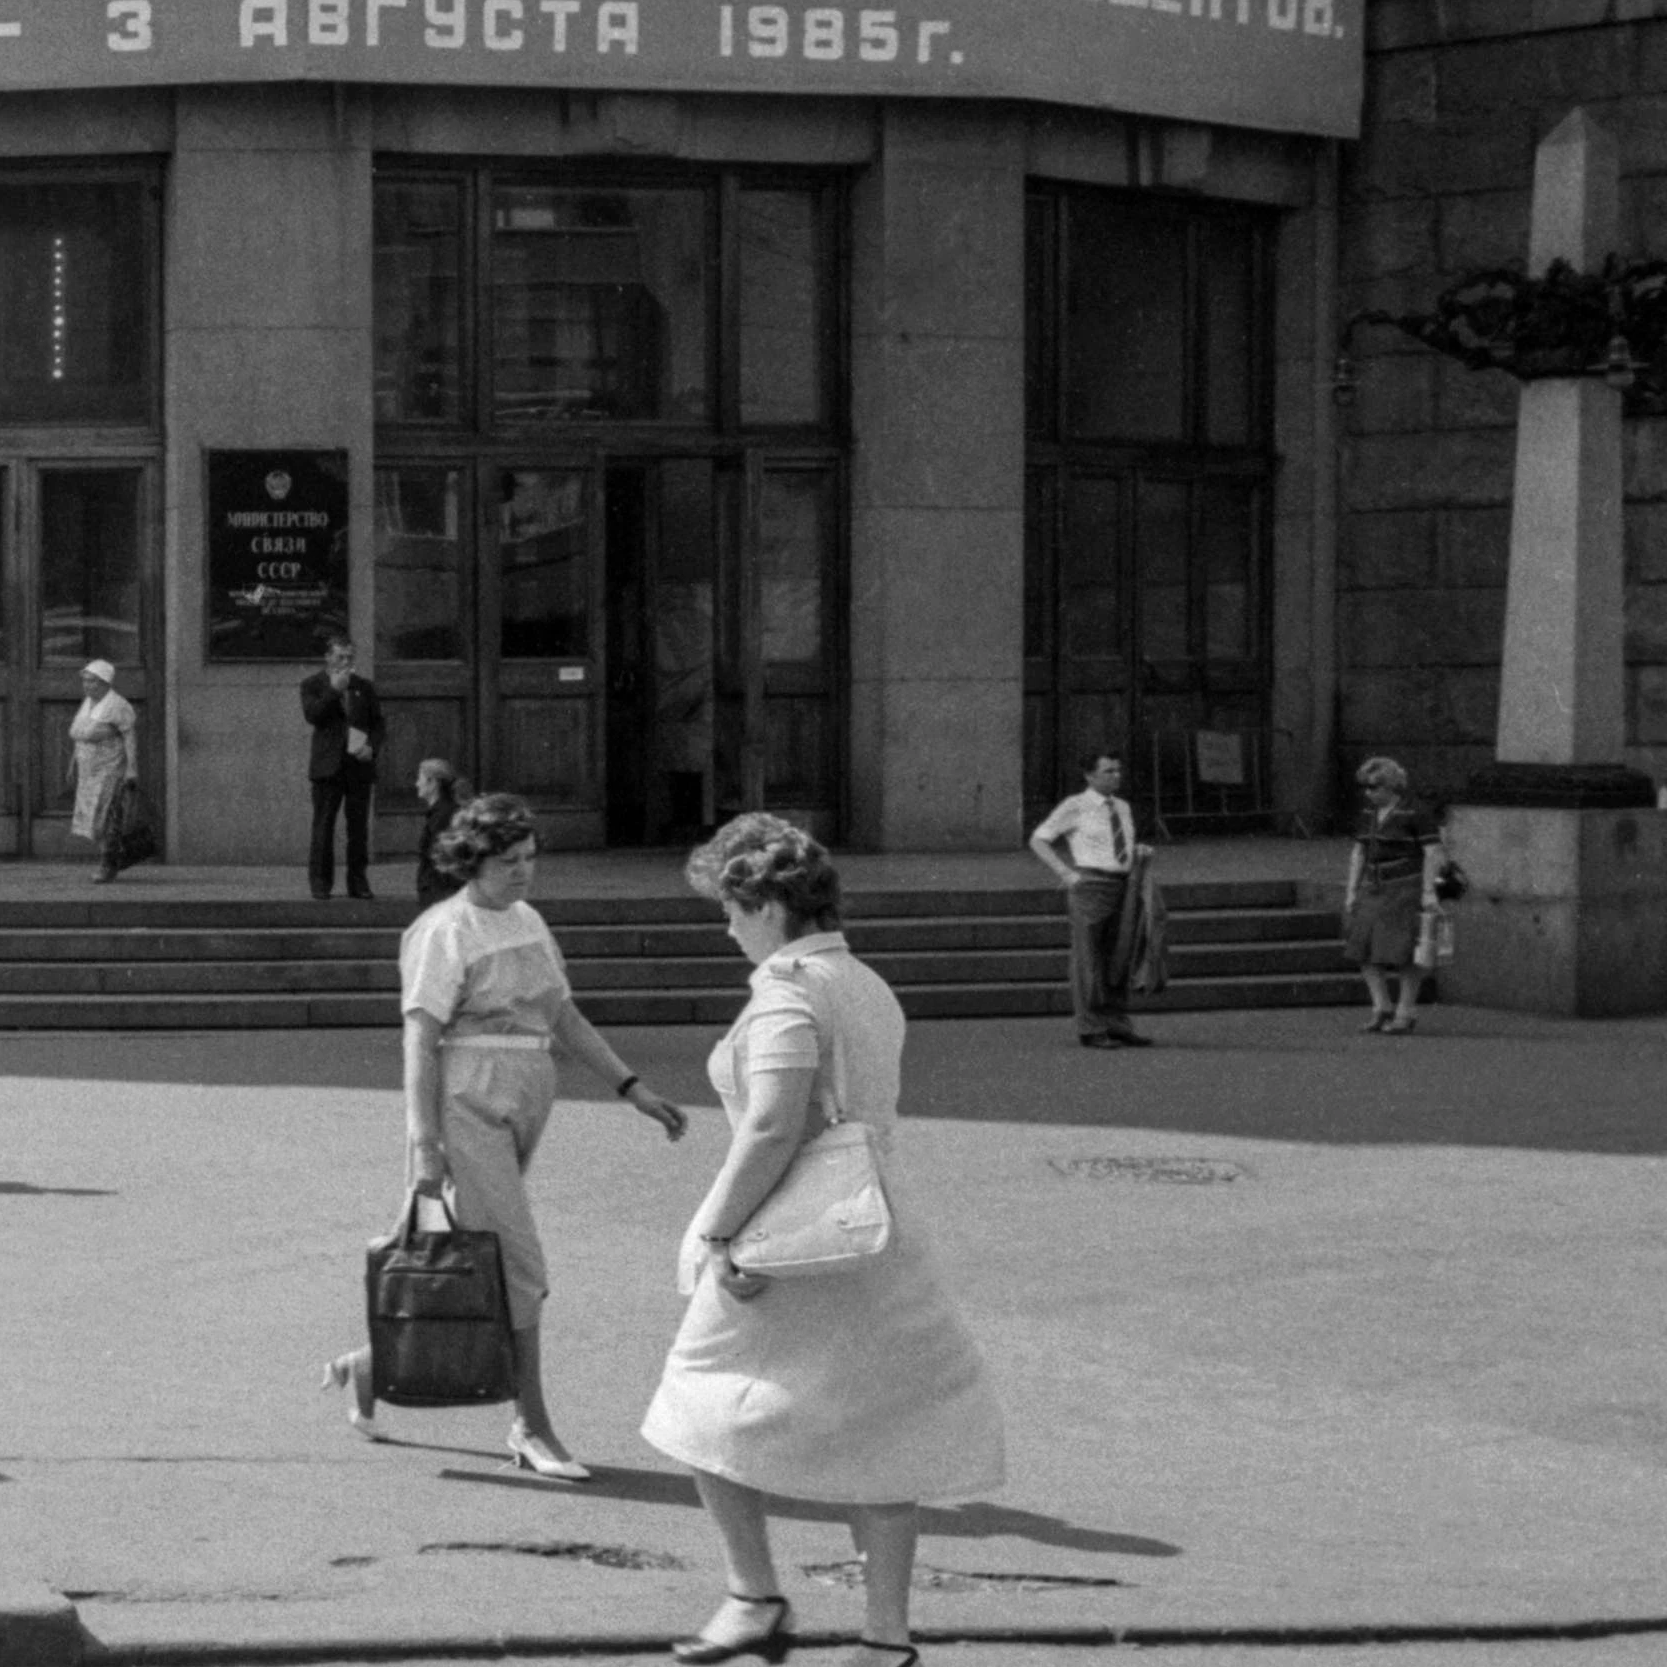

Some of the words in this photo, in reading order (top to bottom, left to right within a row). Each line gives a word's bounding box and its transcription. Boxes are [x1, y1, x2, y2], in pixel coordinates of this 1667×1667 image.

[105, 0, 154, 52] 3
[250, 537, 308, 555] СВЯЗИ
[257, 562, 303, 579] СССР
